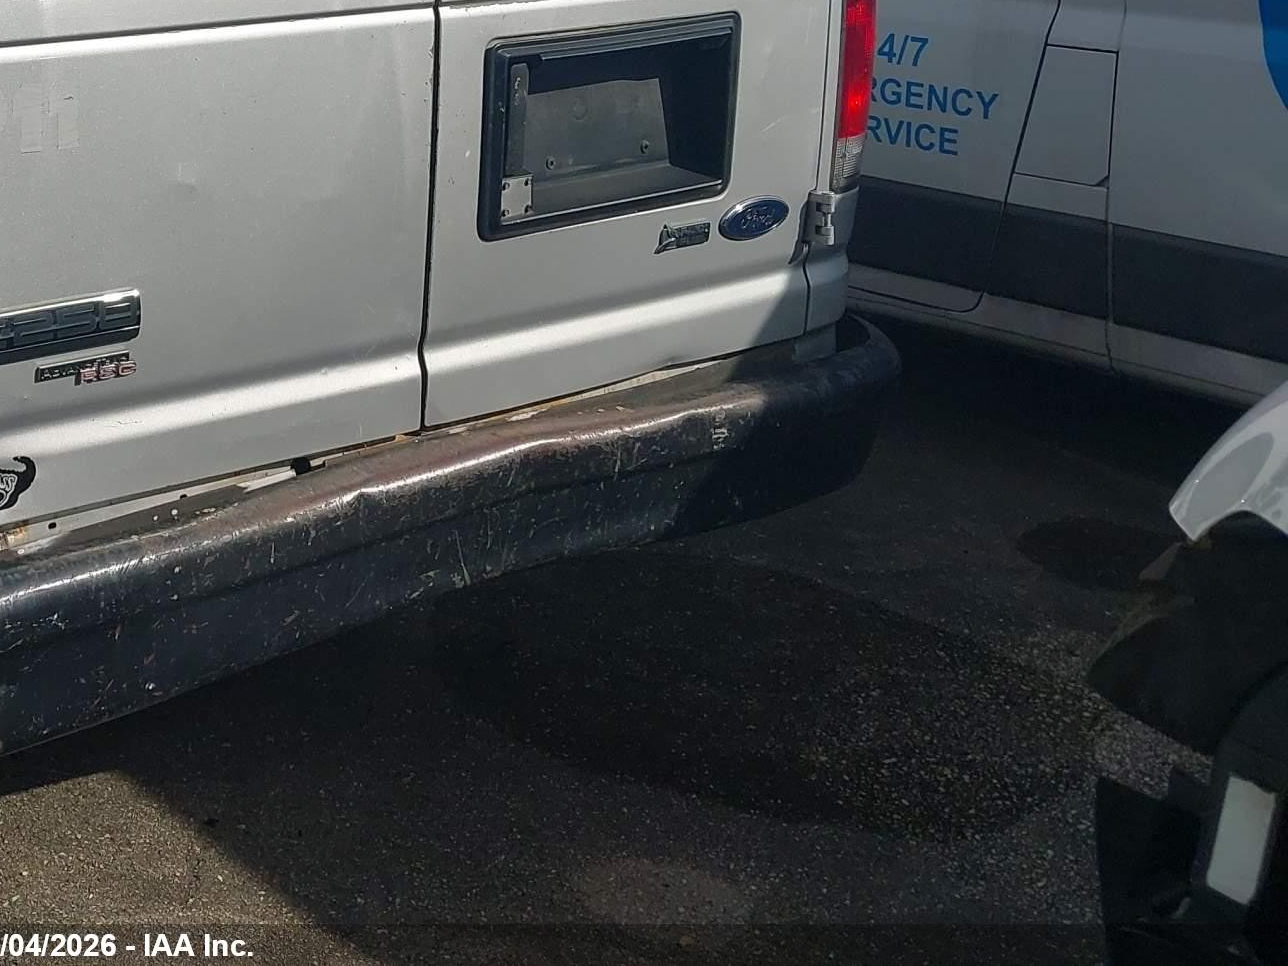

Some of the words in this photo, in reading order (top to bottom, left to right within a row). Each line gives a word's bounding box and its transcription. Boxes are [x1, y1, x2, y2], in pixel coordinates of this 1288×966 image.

[877, 33, 929, 67] 4/7
[867, 114, 959, 156] RVICE
[79, 361, 137, 384] RSC
